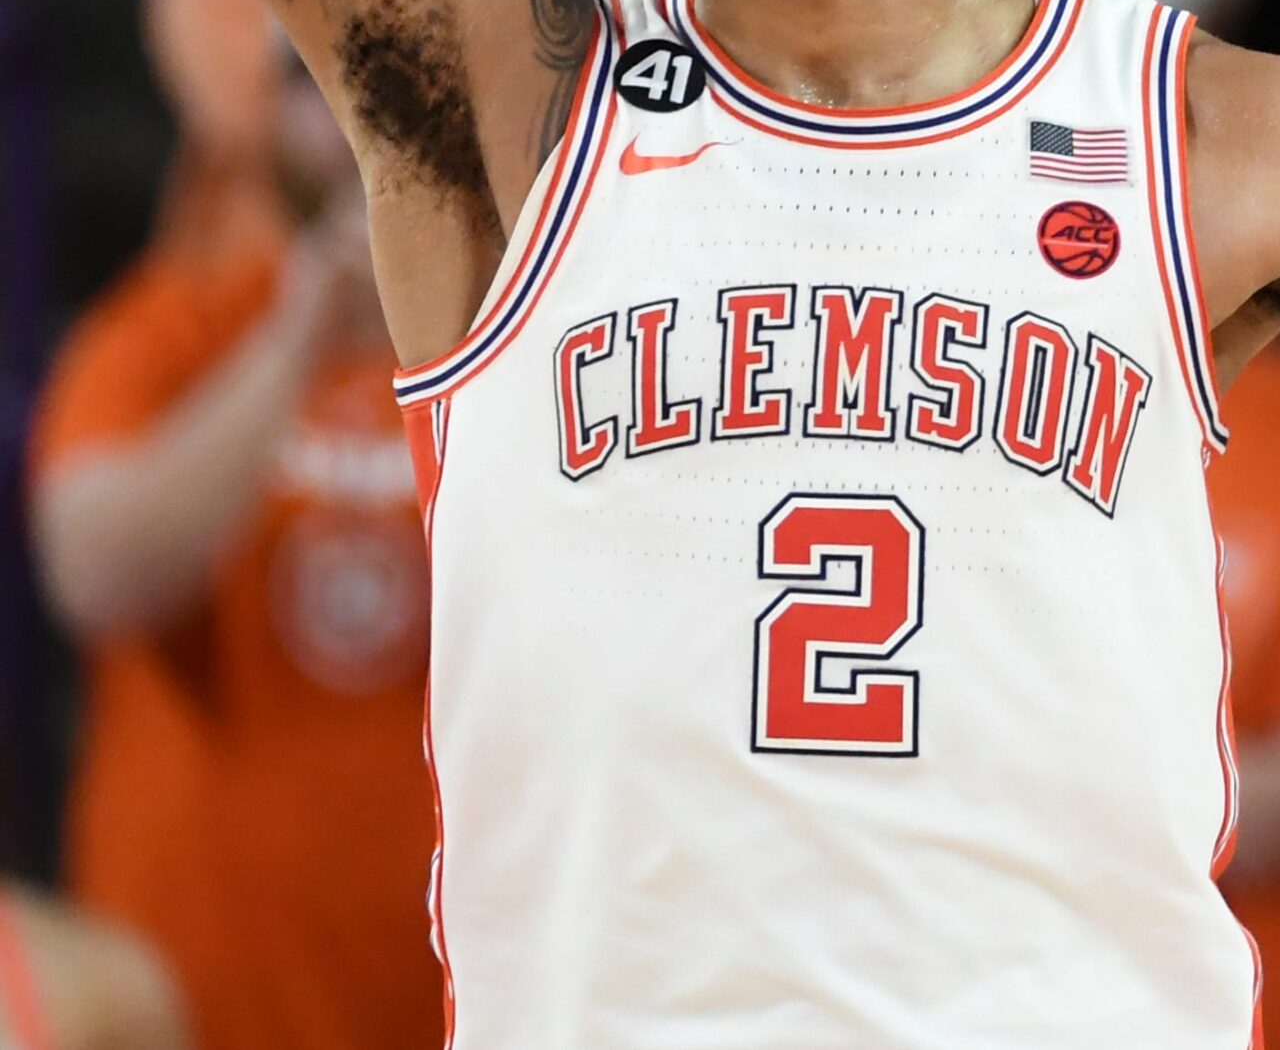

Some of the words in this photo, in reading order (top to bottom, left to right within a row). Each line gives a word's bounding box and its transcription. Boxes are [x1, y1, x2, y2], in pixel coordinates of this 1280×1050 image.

[620, 49, 693, 104] 41
[1051, 226, 1115, 243] ACC
[553, 283, 1153, 519] CLEMSON
[751, 492, 925, 757] 2
